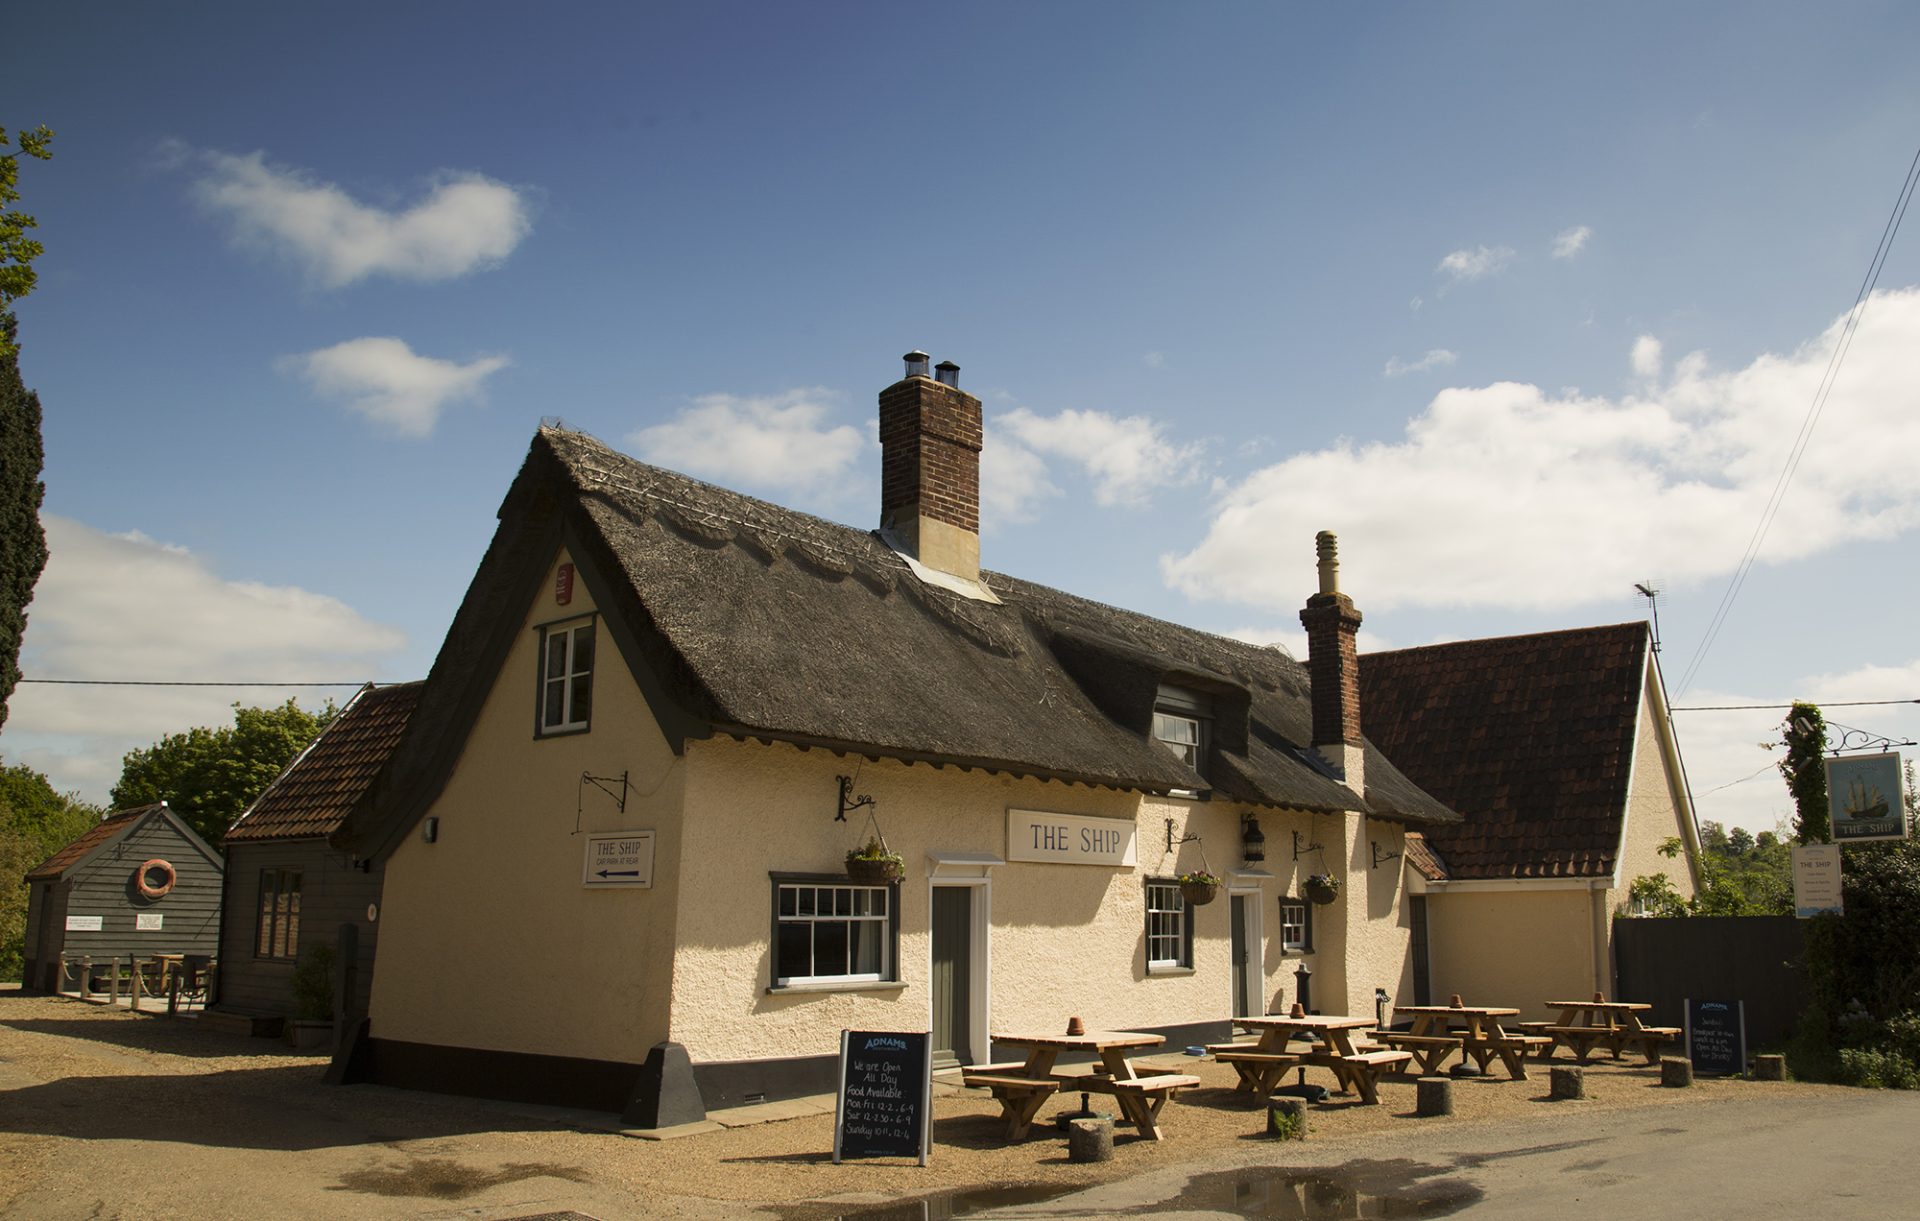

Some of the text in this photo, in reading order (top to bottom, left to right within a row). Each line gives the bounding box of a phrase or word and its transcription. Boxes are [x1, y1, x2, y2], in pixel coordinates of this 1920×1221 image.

[1842, 823, 1894, 834] THE SHIP
[1030, 824, 1120, 853] THE SHIP
[597, 841, 641, 855] THE SHIP
[596, 858, 606, 866] CAR
[619, 857, 626, 865] AT
[864, 1037, 907, 1050] ADNAMS
[854, 1060, 902, 1075] We are Open
[863, 1072, 898, 1090] All Day
[847, 1084, 865, 1097] Food
[846, 1109, 861, 1120] Sat
[846, 1122, 873, 1140] Sunday
